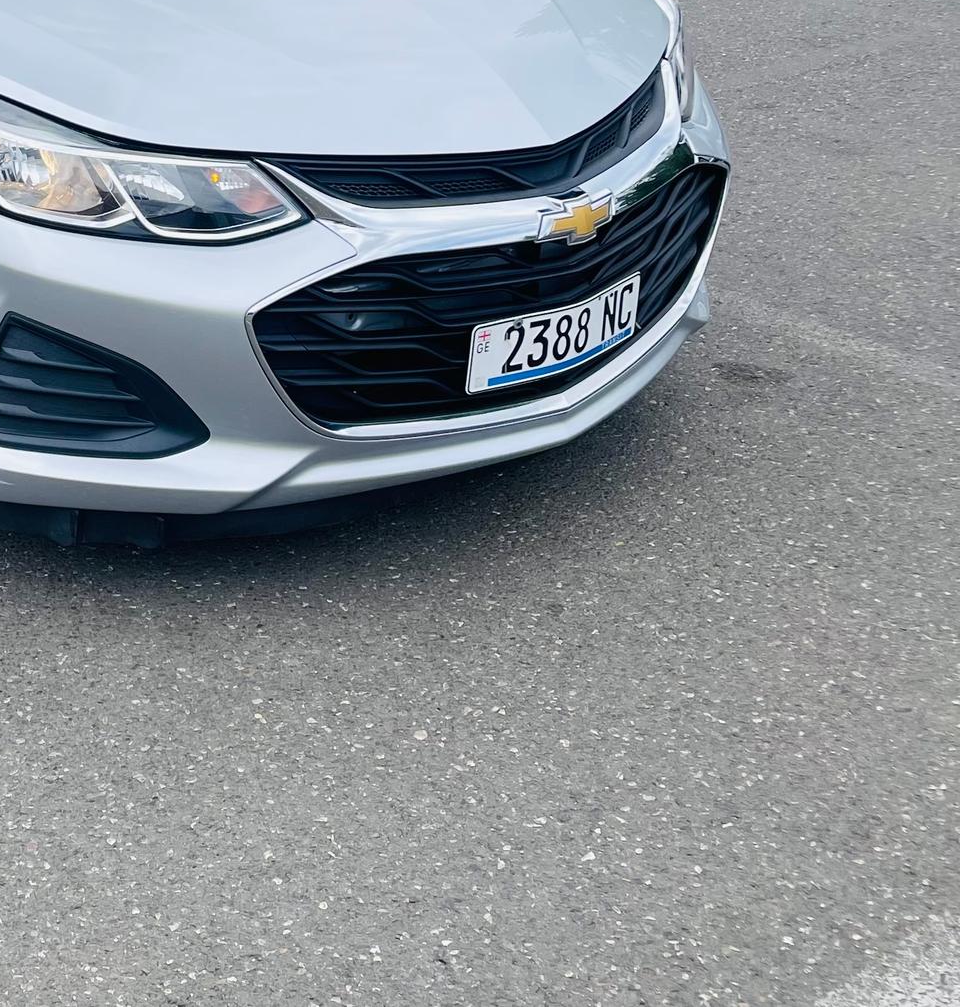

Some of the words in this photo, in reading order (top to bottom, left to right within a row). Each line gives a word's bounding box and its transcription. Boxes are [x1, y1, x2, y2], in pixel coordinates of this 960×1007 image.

[476, 341, 490, 354] GE
[501, 307, 591, 374] 2388
[600, 282, 634, 342] NC
